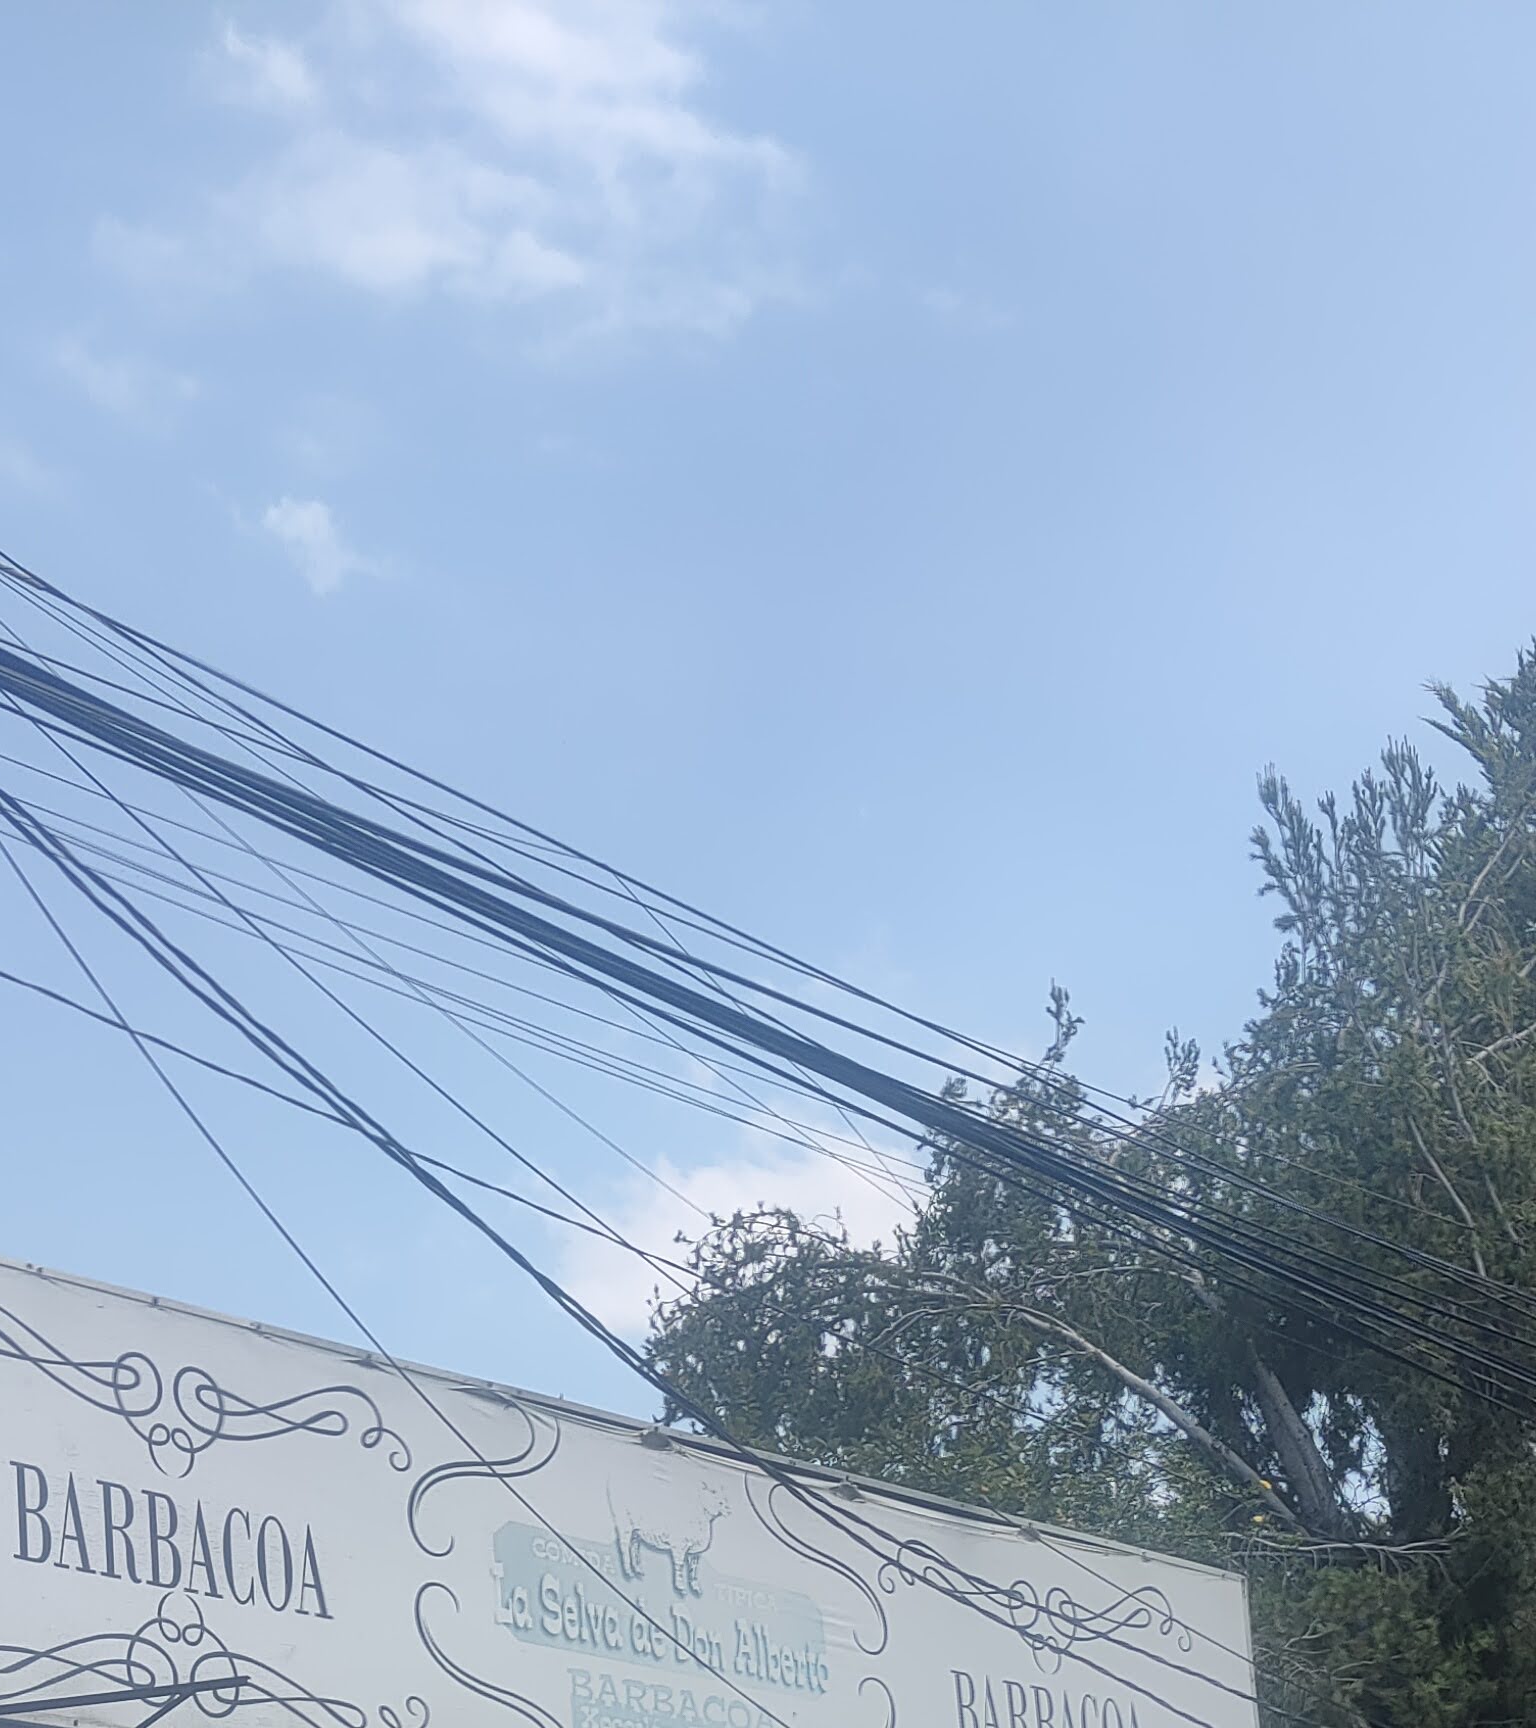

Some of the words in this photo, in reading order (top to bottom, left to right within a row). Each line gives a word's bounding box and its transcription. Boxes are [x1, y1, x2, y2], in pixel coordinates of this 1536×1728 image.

[8, 1460, 334, 1622] BARBACOA
[489, 1560, 533, 1631] La
[540, 1573, 624, 1651] Selva
[629, 1597, 666, 1662] de
[670, 1602, 725, 1674] Don
[733, 1618, 830, 1695] Alberto
